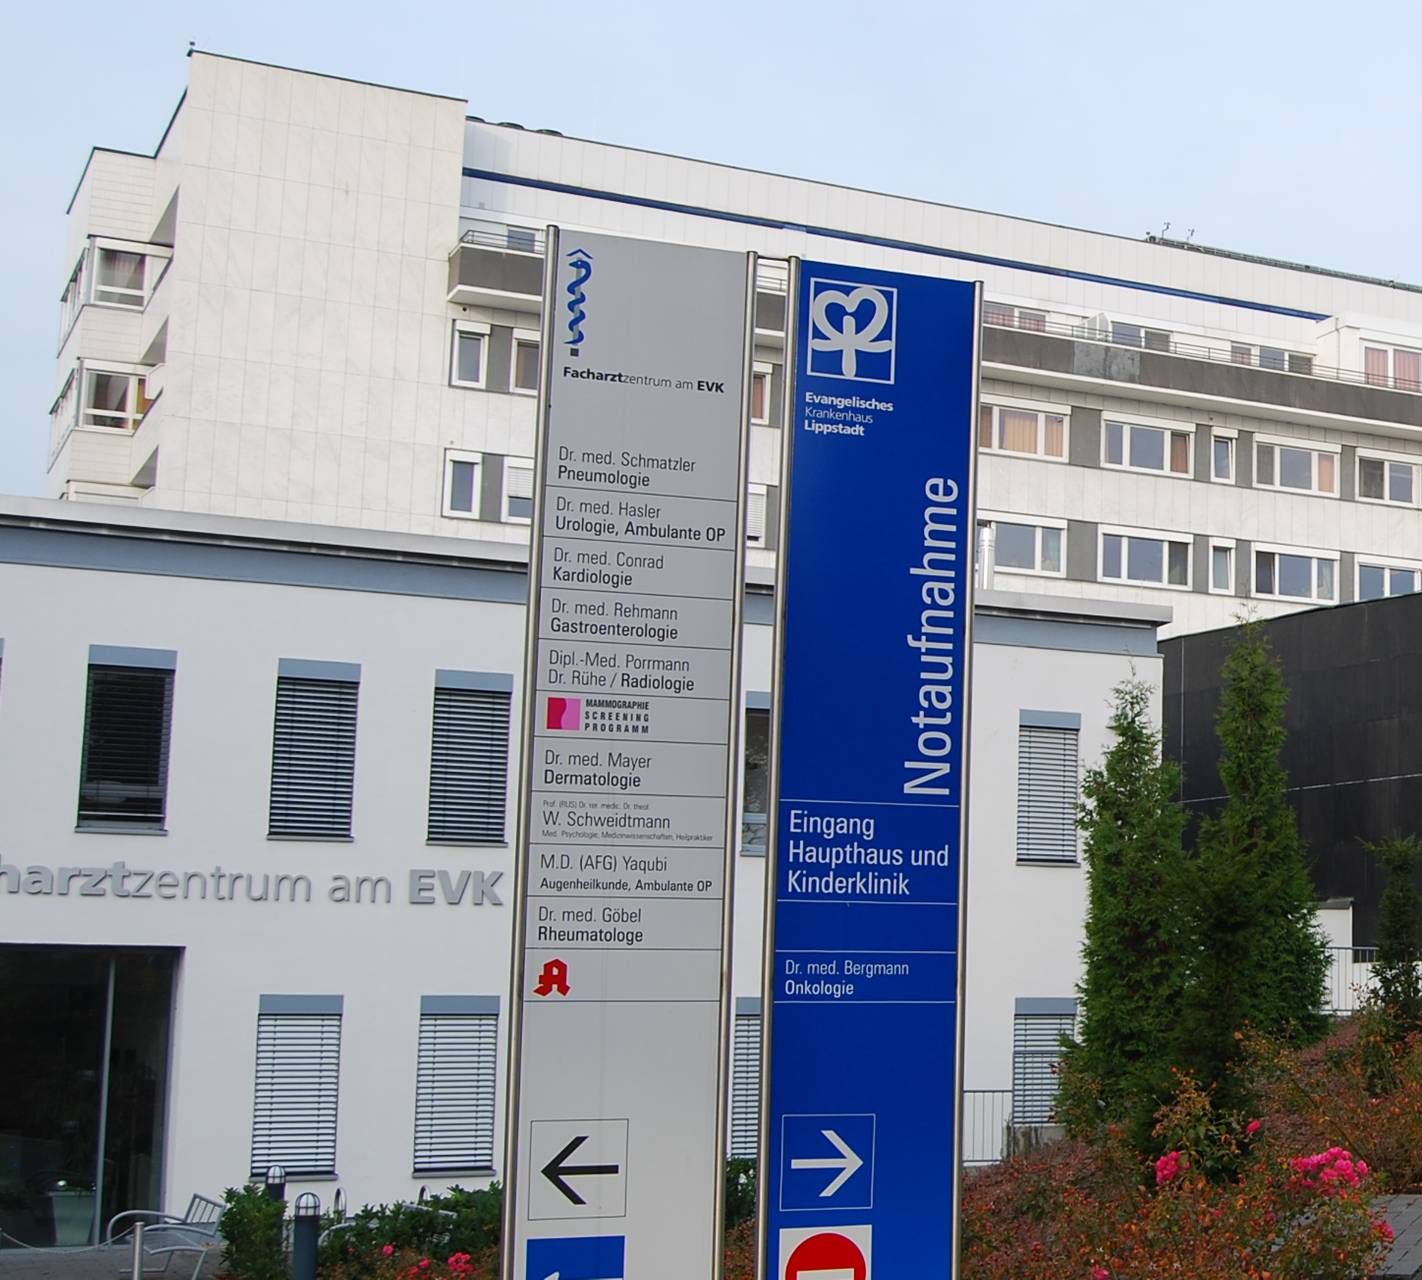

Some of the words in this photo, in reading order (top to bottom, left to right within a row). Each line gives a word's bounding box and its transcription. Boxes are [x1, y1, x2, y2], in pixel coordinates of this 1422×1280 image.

[563, 366, 671, 389] Facharztzentrum
[675, 379, 693, 390] am
[697, 380, 725, 393] EVK
[805, 392, 894, 412] Evangelisches
[805, 407, 873, 423] Krankenhaus
[804, 420, 865, 436] Lippstadt
[559, 446, 576, 461] Dr.
[582, 451, 615, 465] med.
[621, 451, 696, 472] Schmatzler
[558, 465, 650, 488] Pneumologie
[556, 496, 573, 511] Dr.
[579, 501, 613, 515] med.
[618, 502, 661, 518] Hasler
[555, 516, 619, 536] Urologie,
[624, 521, 701, 541] Ambulante
[706, 527, 726, 541] OP
[554, 547, 571, 562] Dr.
[577, 552, 611, 566] med.
[616, 552, 664, 569] Conrad
[553, 566, 633, 588] Kardiologie
[552, 598, 569, 613] Dr.
[575, 602, 608, 616] med.
[614, 602, 678, 620] Rehmann
[551, 617, 678, 641] Gastroenterologie
[903, 477, 959, 795] Notaufnahme
[549, 650, 620, 668] Dipl.-Med.
[625, 654, 690, 672] Porrmann
[548, 669, 566, 685] Dr.
[572, 670, 606, 687] Rühe
[621, 673, 694, 693] Radiologie
[585, 698, 649, 710] MAMMOGRAPHIE
[585, 711, 649, 722] SCREENING
[584, 723, 649, 733] PROGRAMM
[545, 750, 563, 765] Dr.
[568, 752, 602, 766] med.
[608, 752, 652, 771] Mayer
[544, 769, 641, 790] Dermatologie
[543, 811, 561, 826] W.
[567, 811, 671, 830] Schweidtmann
[789, 810, 875, 840] Eingang
[540, 854, 573, 870] M.D.
[579, 855, 617, 872] (AFG)
[623, 856, 668, 874] Yaqubi
[788, 840, 903, 868] Haupthaus
[911, 845, 949, 867] und
[328, 872, 392, 903] am
[408, 868, 505, 906] EVK
[540, 878, 631, 892] Augenheilkunde,
[635, 880, 693, 892] Ambulante
[697, 880, 713, 892] OP
[787, 870, 910, 895] Kinderklinik
[538, 906, 556, 922] Dr.
[562, 908, 596, 922] med.
[602, 907, 642, 923] Göbel
[538, 926, 643, 945] Rheumatologe
[785, 959, 802, 975] Dr.
[807, 960, 839, 975] med.
[844, 960, 909, 978] Bergmann
[785, 980, 854, 998] Onkologie
